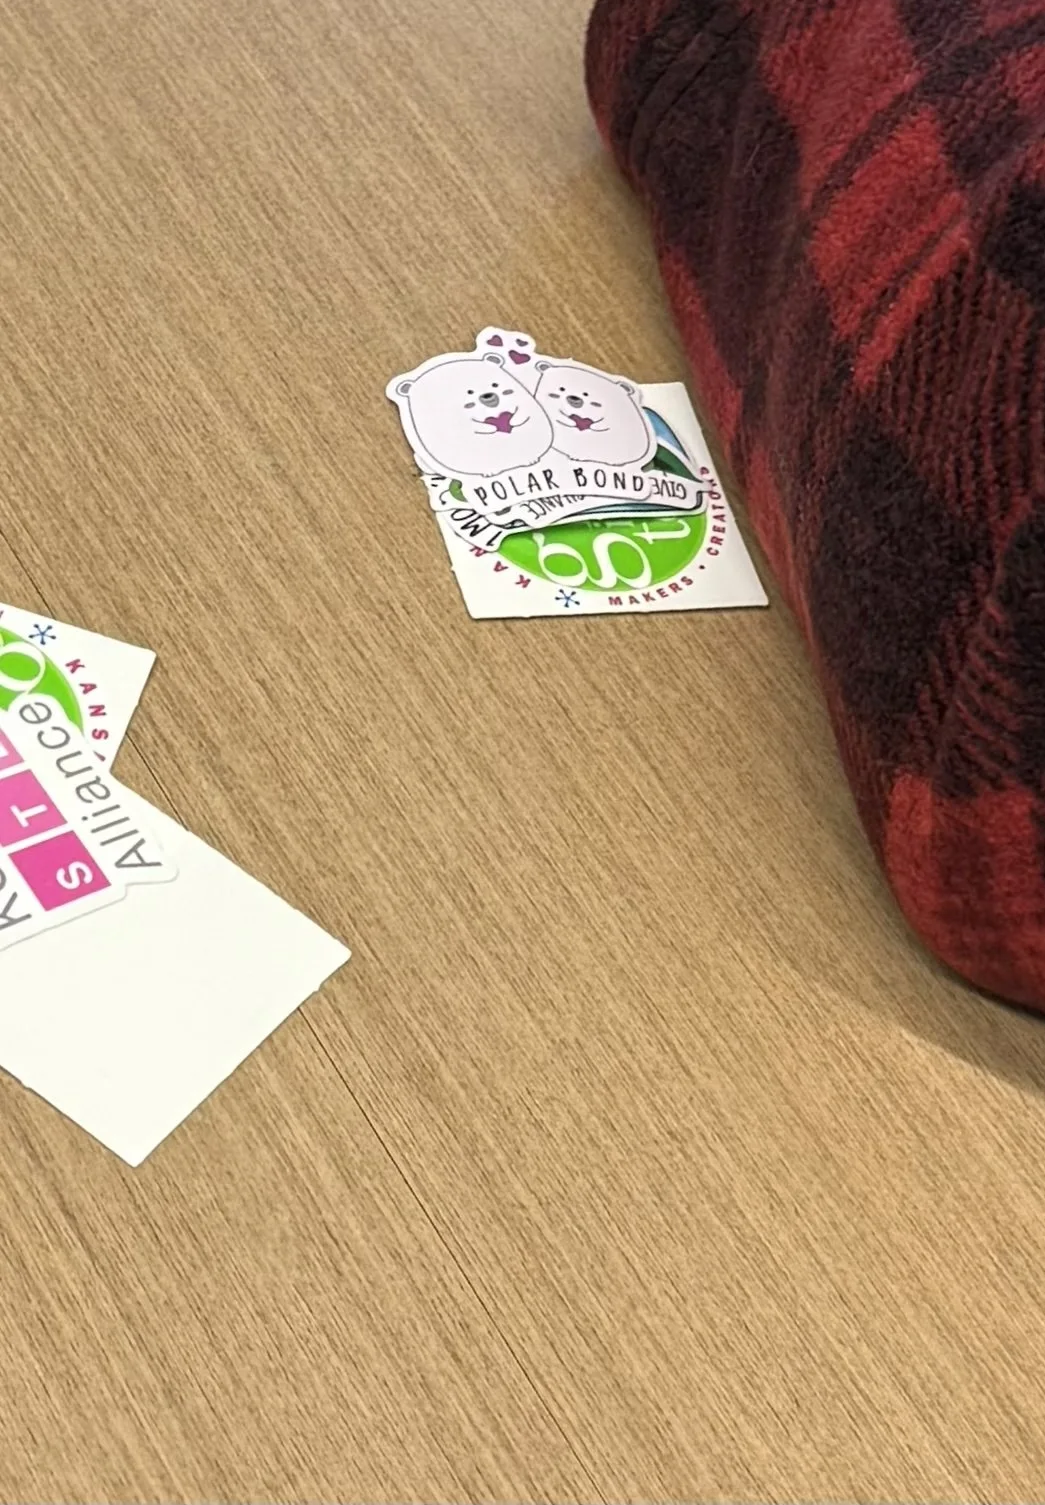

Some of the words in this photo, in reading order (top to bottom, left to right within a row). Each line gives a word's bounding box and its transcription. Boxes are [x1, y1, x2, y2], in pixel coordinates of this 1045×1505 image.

[474, 468, 560, 507] POLAR
[573, 467, 644, 492] BOND
[650, 476, 687, 500] GIVE
[607, 575, 694, 607] MAKERS
[65, 658, 109, 762] KANS
[18, 701, 163, 869] Alliance
